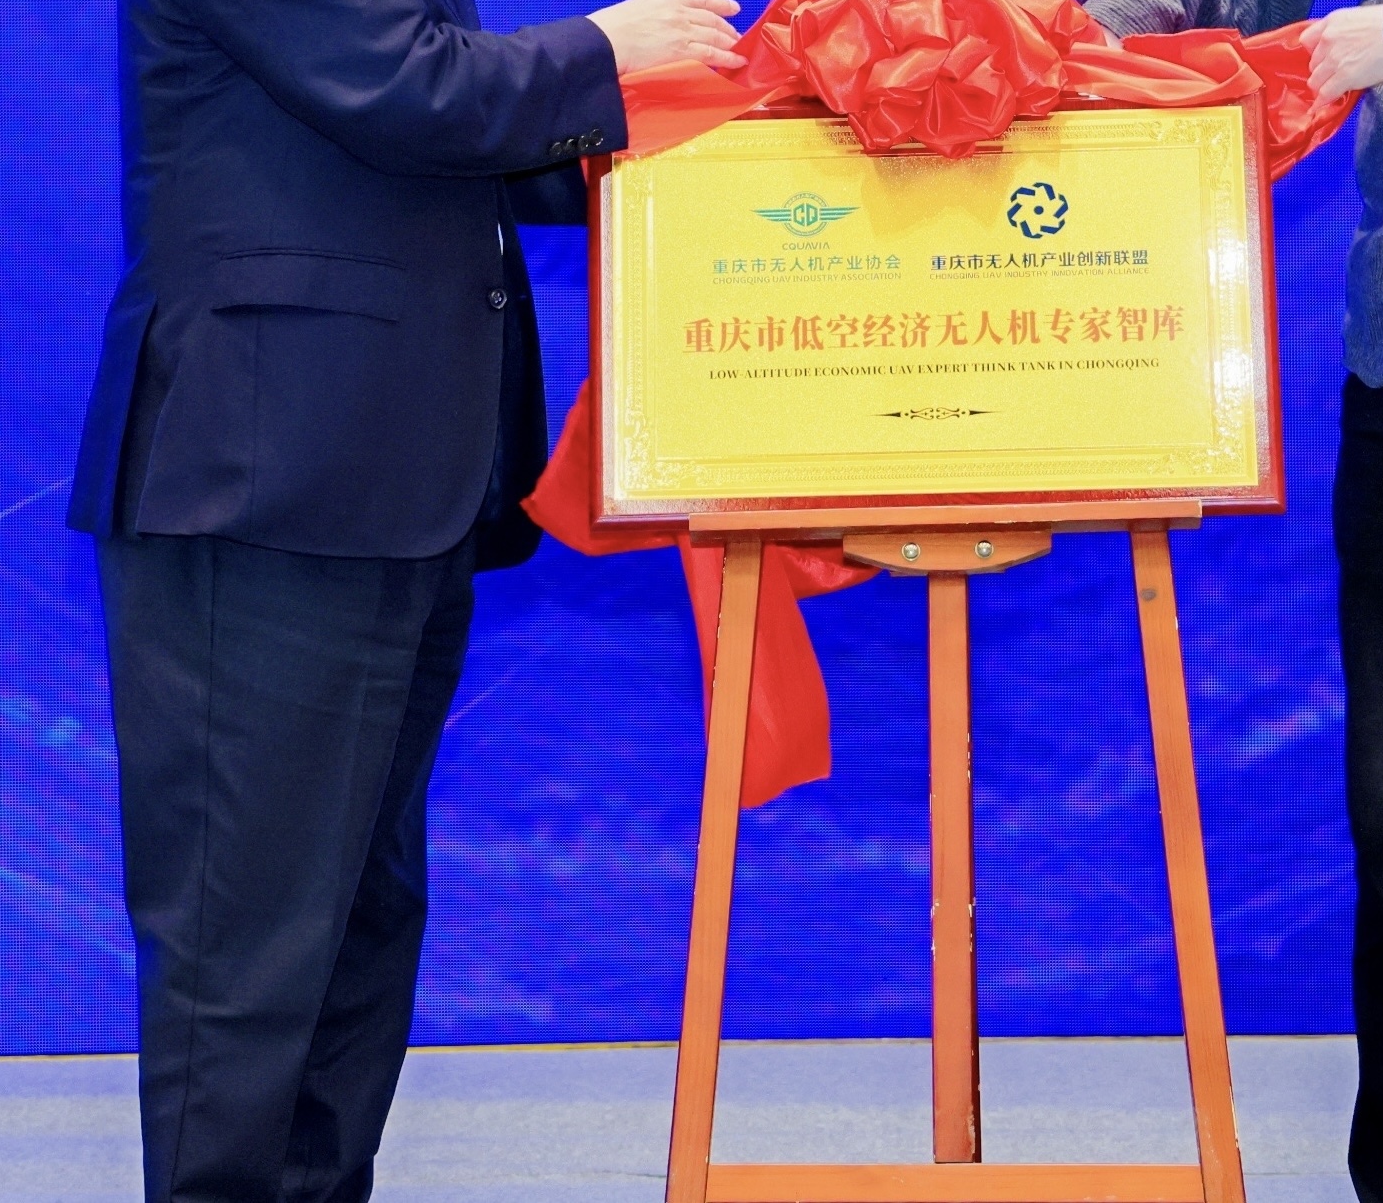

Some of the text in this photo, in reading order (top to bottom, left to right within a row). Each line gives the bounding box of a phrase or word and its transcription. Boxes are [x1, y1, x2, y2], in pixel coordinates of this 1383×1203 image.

[781, 241, 831, 251] CQUAVIA
[712, 254, 901, 274] 重庆市无人机产业协会
[930, 250, 1150, 271] 重庆市无人机产业创新联盟
[712, 272, 902, 285] CHONGQING UAV INDUSTRY ASSOCIATION
[929, 267, 1150, 280] CHONGQING UAV INDUSTRY INNOVATION ALLIANCE
[682, 304, 1185, 354] 重庆市低空经济无人机专家智库
[709, 358, 1160, 380] LOW-ALTITUDE ECONOMIC UAV EXPERT THINK TANK IN CHONGQING
